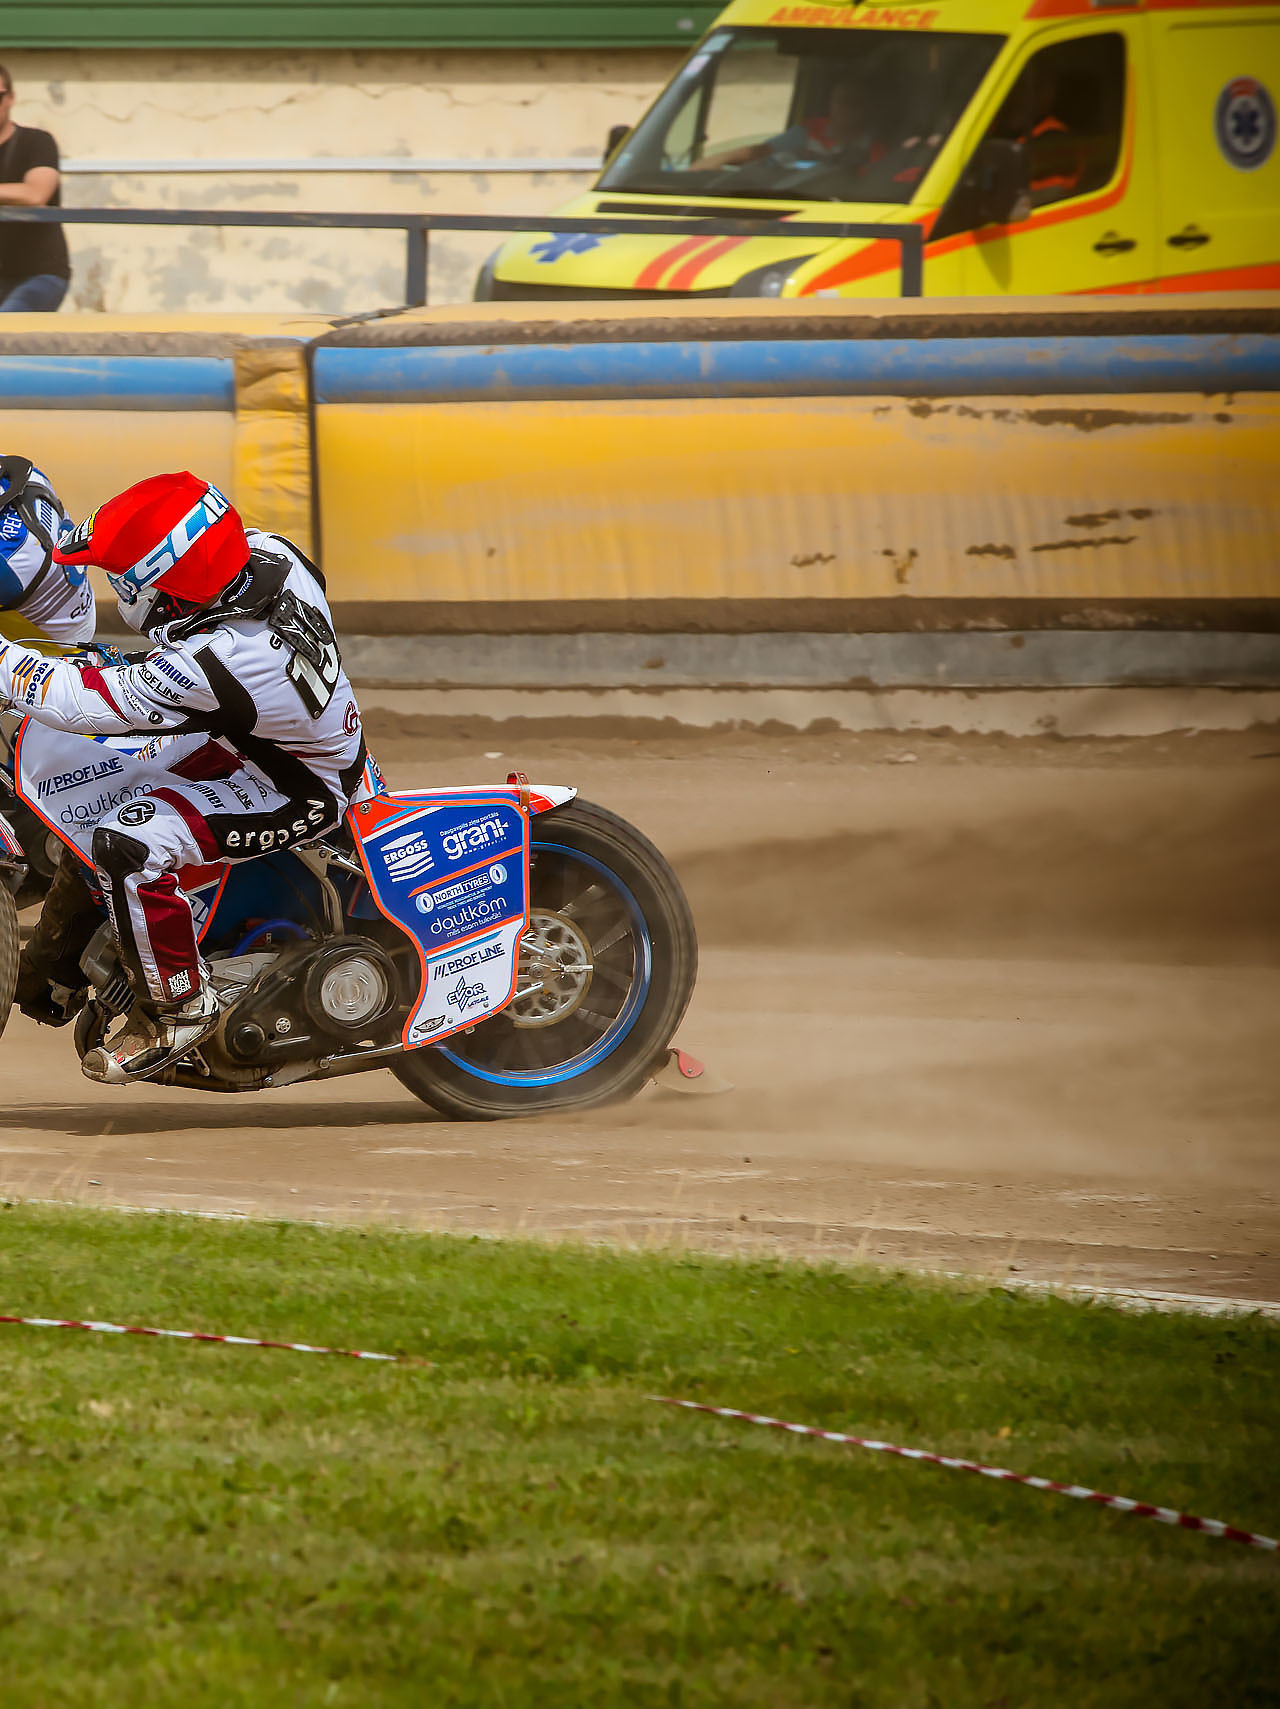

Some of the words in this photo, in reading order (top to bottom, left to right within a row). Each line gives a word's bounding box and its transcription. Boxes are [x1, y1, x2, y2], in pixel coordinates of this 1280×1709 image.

[767, 6, 940, 30] AMBULANCE
[25, 662, 50, 706] ERGOSS
[383, 839, 429, 865] ERGOSS
[433, 885, 463, 904] NORTH
[462, 875, 490, 892] TYRES
